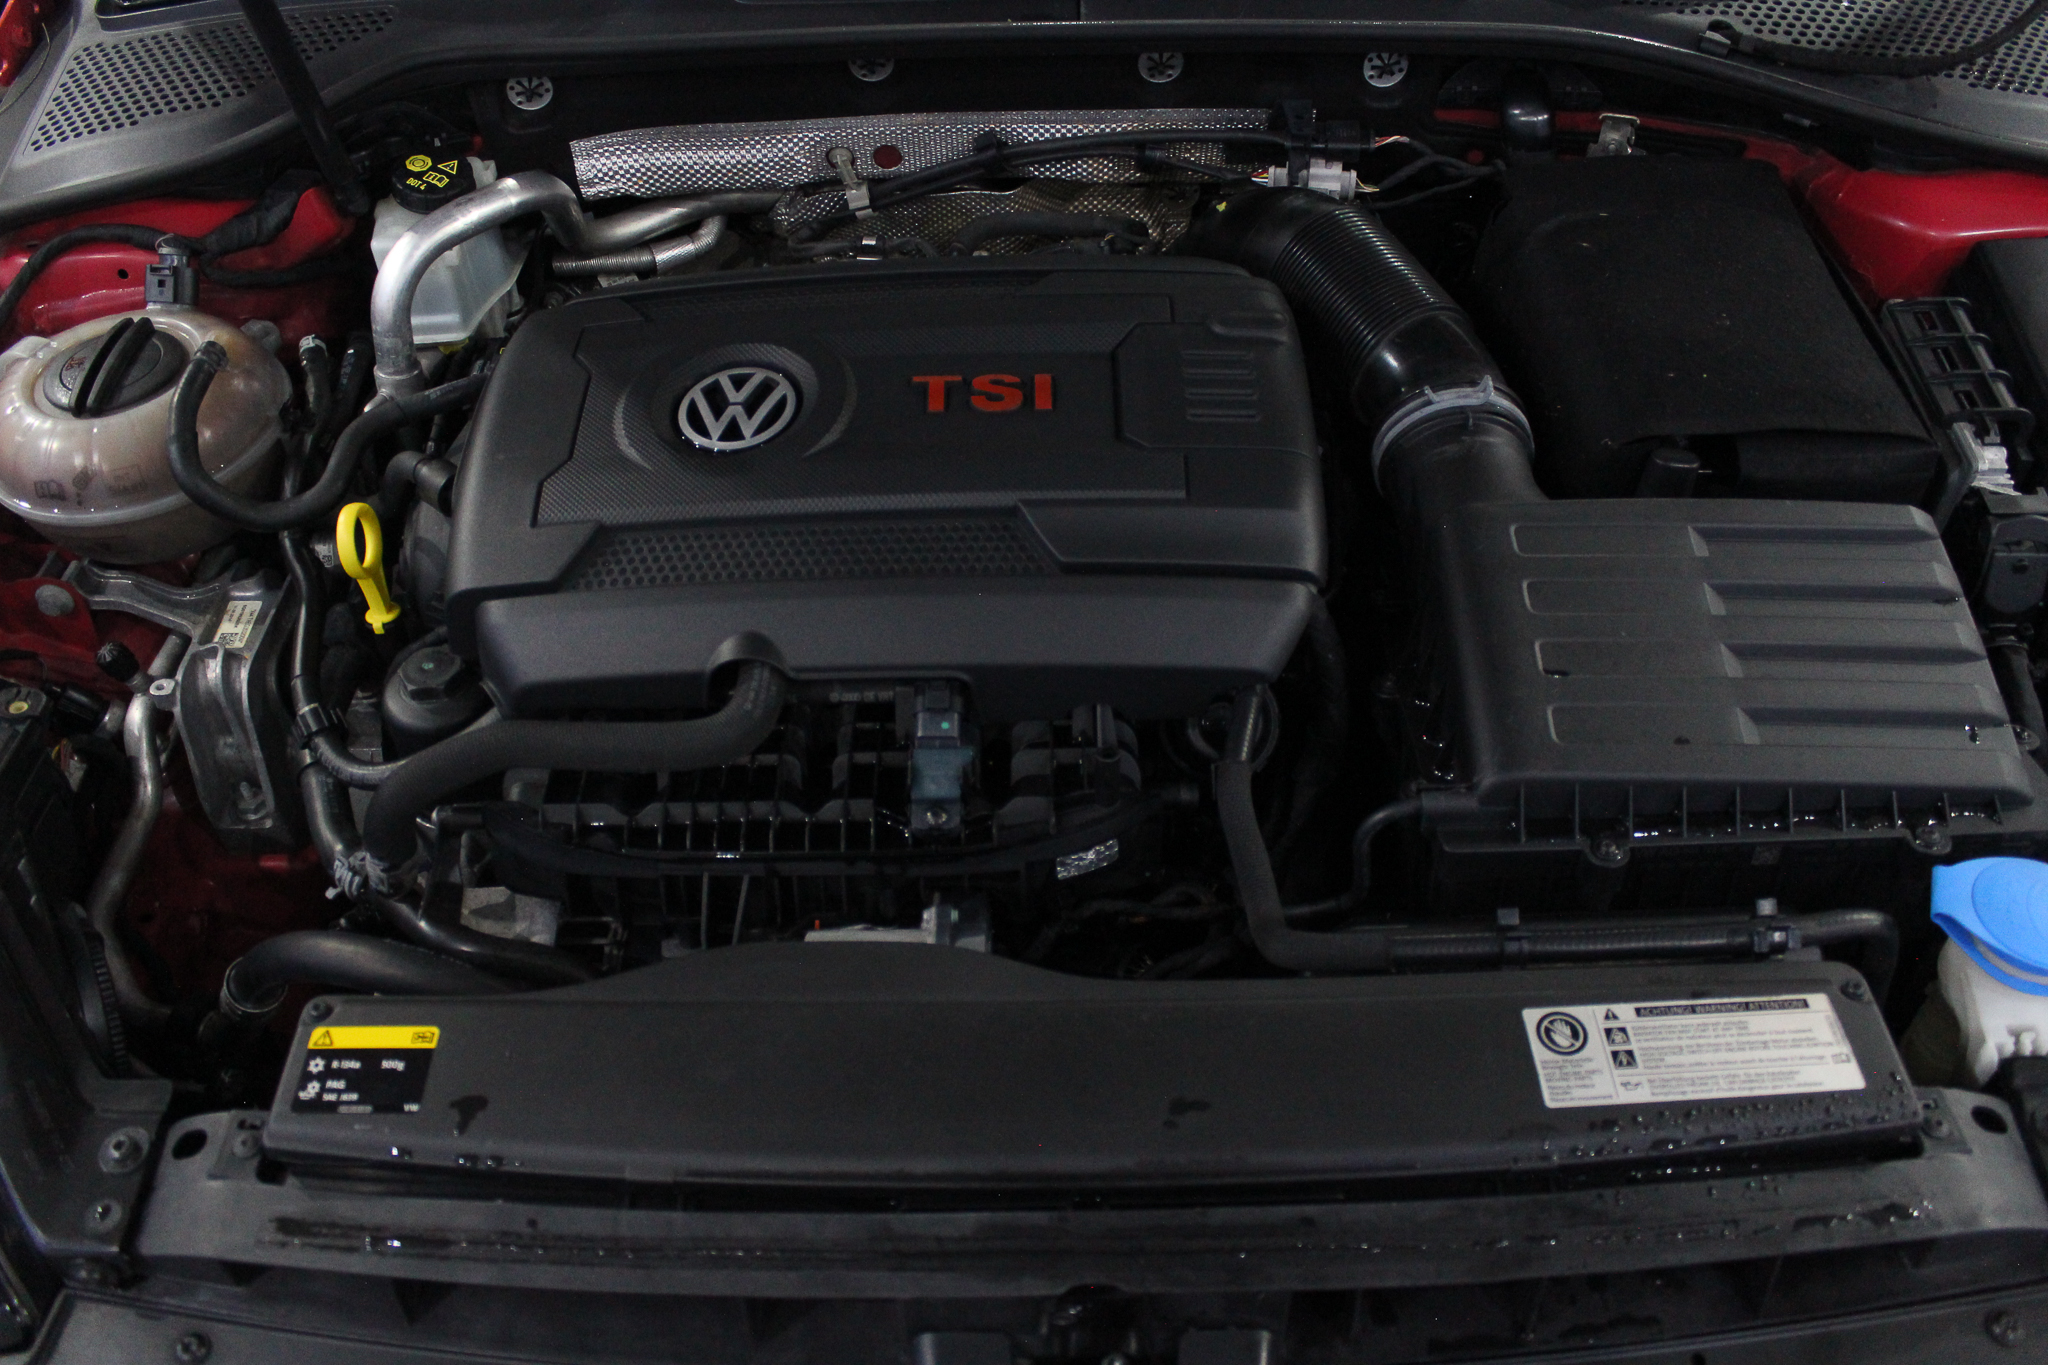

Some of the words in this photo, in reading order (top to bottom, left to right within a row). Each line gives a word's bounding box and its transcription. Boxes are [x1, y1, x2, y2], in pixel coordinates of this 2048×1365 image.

[406, 178, 422, 188] DOT
[678, 367, 797, 451] VW
[912, 373, 1054, 412] TSI
